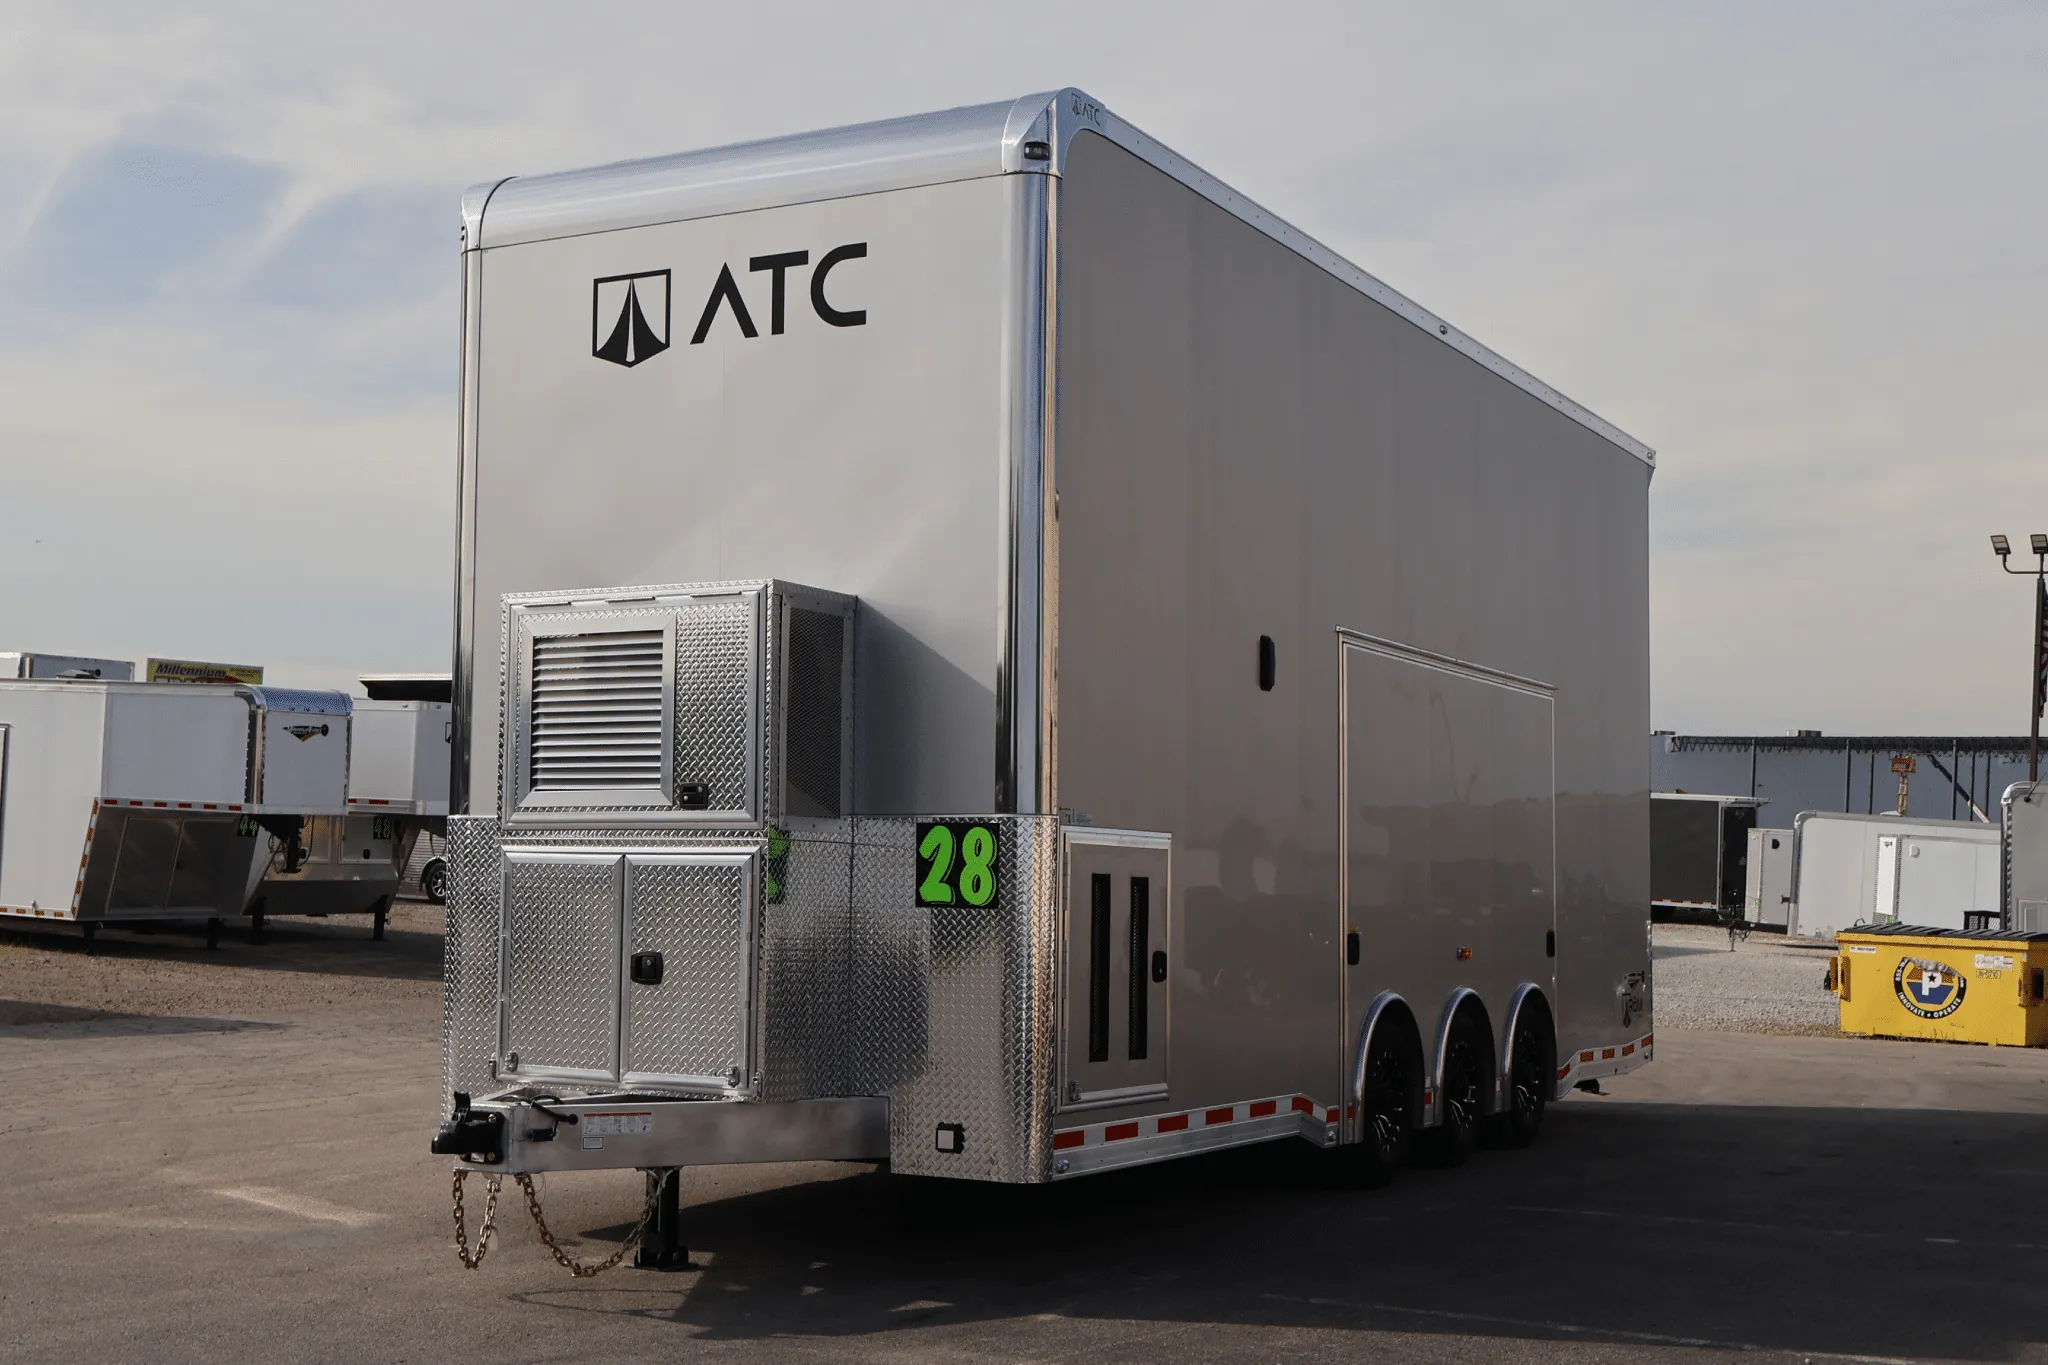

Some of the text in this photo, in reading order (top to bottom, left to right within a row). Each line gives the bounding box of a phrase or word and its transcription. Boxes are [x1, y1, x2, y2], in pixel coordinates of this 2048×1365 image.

[1082, 103, 1100, 127] ATC
[690, 242, 868, 345] ATC
[156, 663, 227, 678] Millennium
[918, 825, 998, 906] 28
[1898, 991, 1961, 1018] INNOVATE OPERATE
